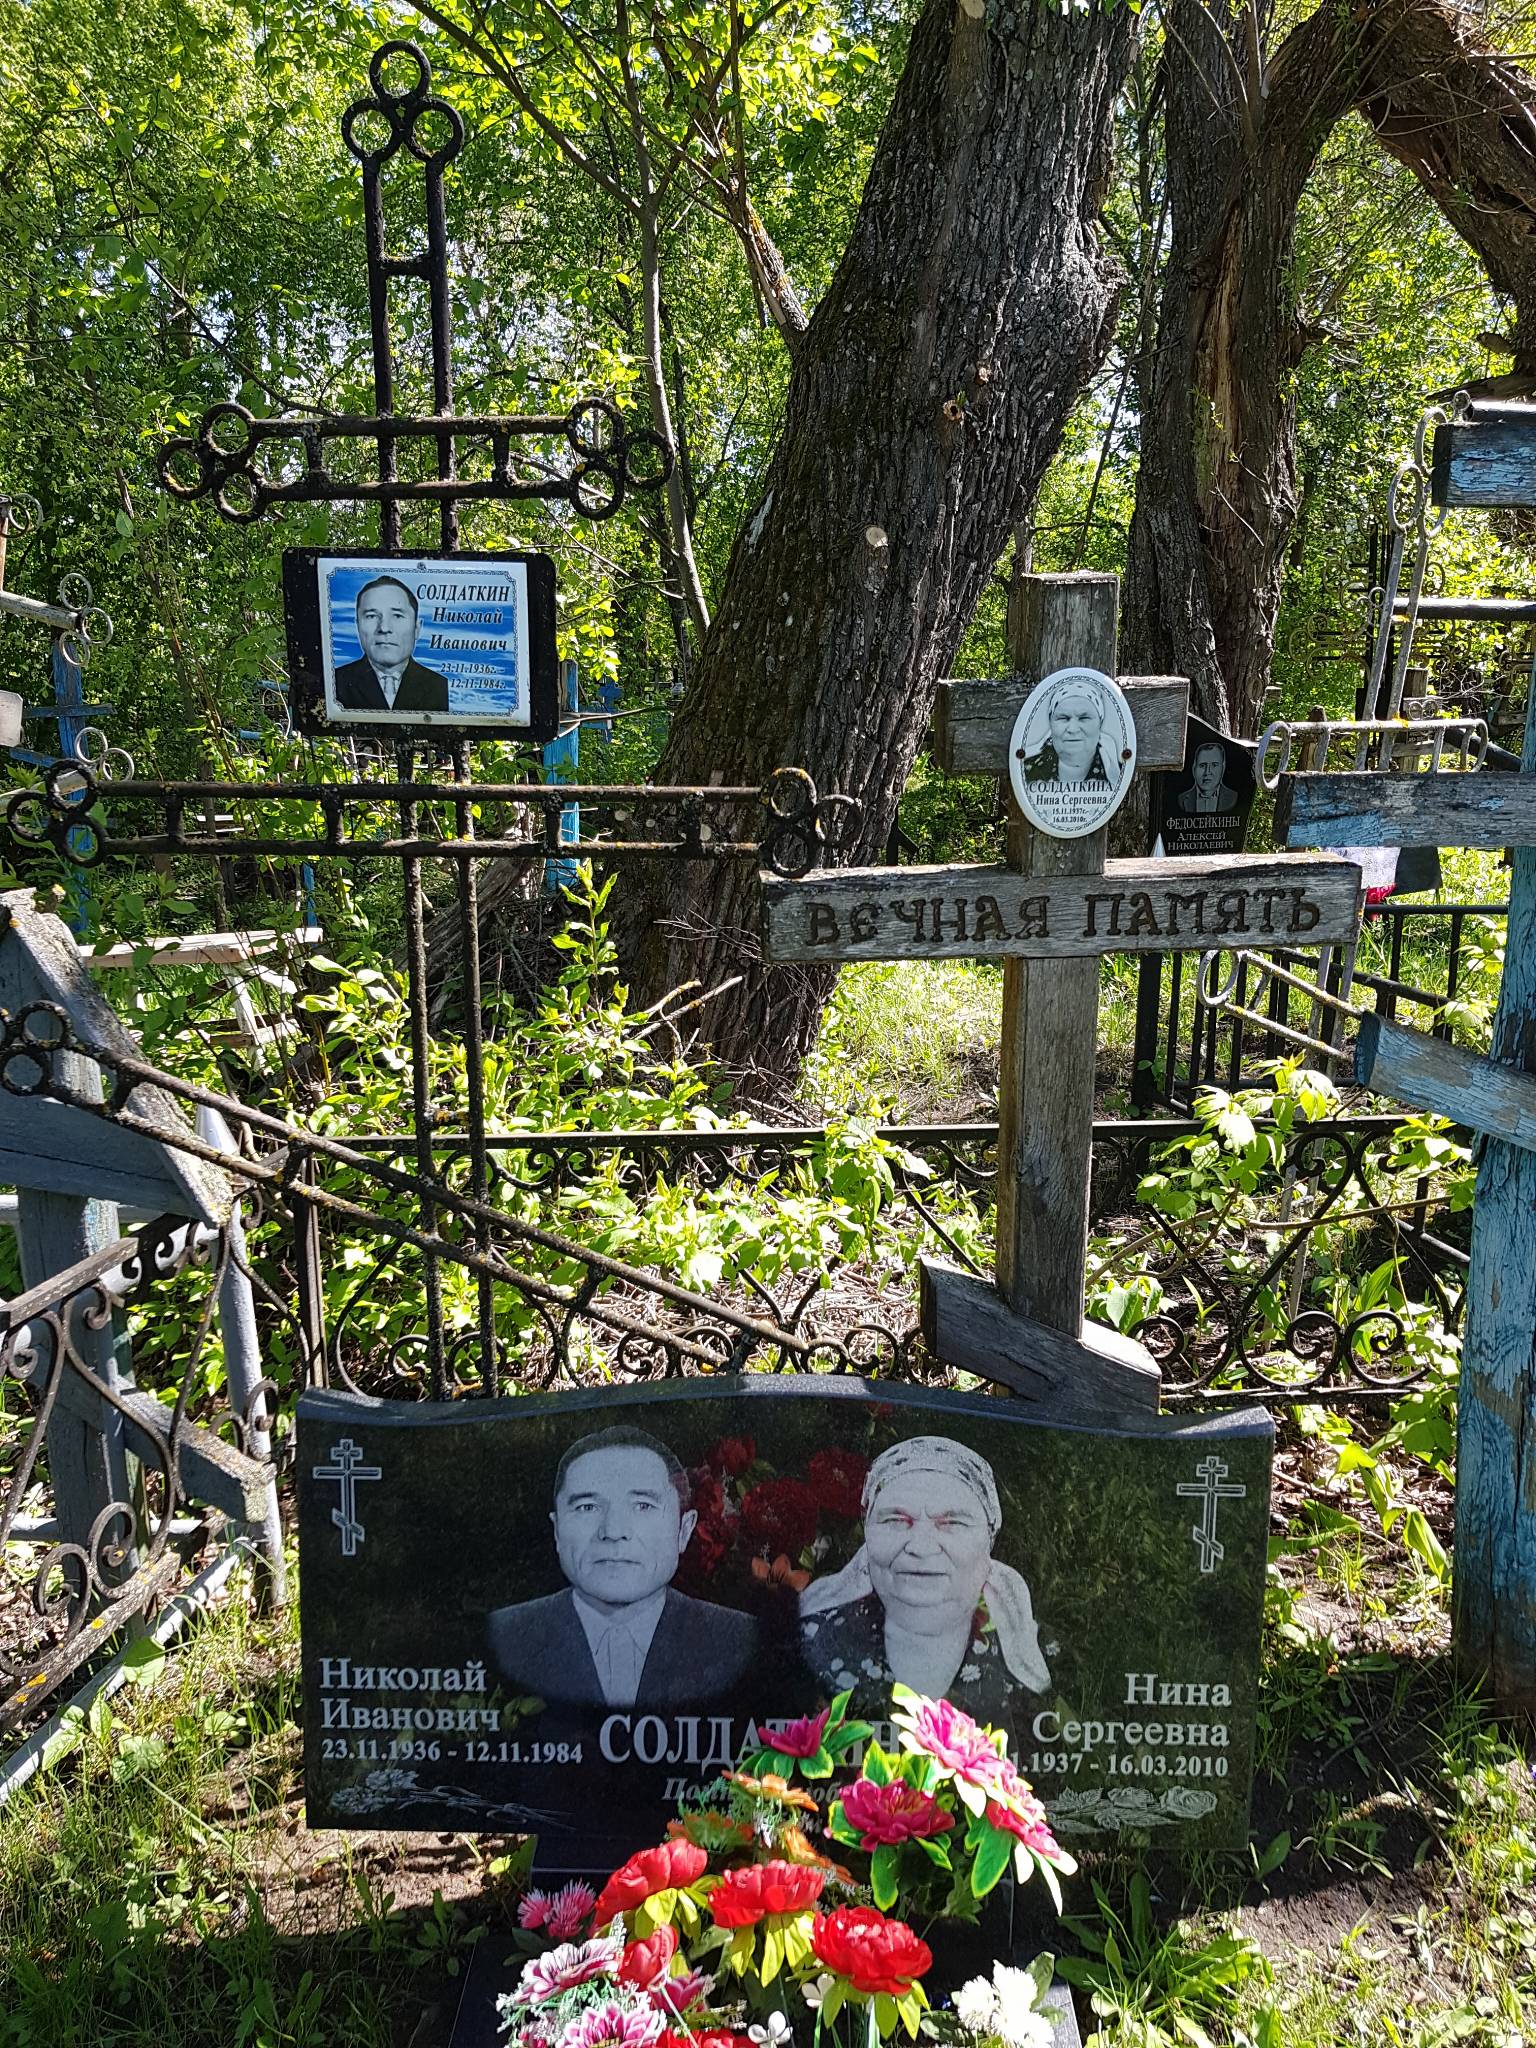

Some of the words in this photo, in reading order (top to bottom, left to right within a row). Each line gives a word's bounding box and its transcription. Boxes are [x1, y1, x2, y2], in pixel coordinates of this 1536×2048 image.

[416, 583, 510, 604] СОЛДАТКИН
[433, 606, 503, 624] Николай
[430, 634, 508, 651] Иванович
[1029, 781, 1113, 794] СОЛДАТКИНА
[1036, 794, 1060, 805] Нина
[1062, 794, 1107, 808] Сергеевна
[1166, 815, 1241, 830] ФЕДОСЕЙКИНЫ
[804, 895, 1050, 946] ВЕЧНАЯ
[1083, 886, 1320, 938] ПАМЯТЬ
[319, 1657, 487, 1692] Николай
[1123, 1673, 1232, 1707] Нина
[321, 1697, 501, 1732] Иванович
[1032, 1711, 1230, 1752] Сергеевна
[322, 1738, 440, 1761] 23.11.1936
[465, 1740, 583, 1764] 12.11.1984
[1108, 1755, 1229, 1777] 16.03.2010
